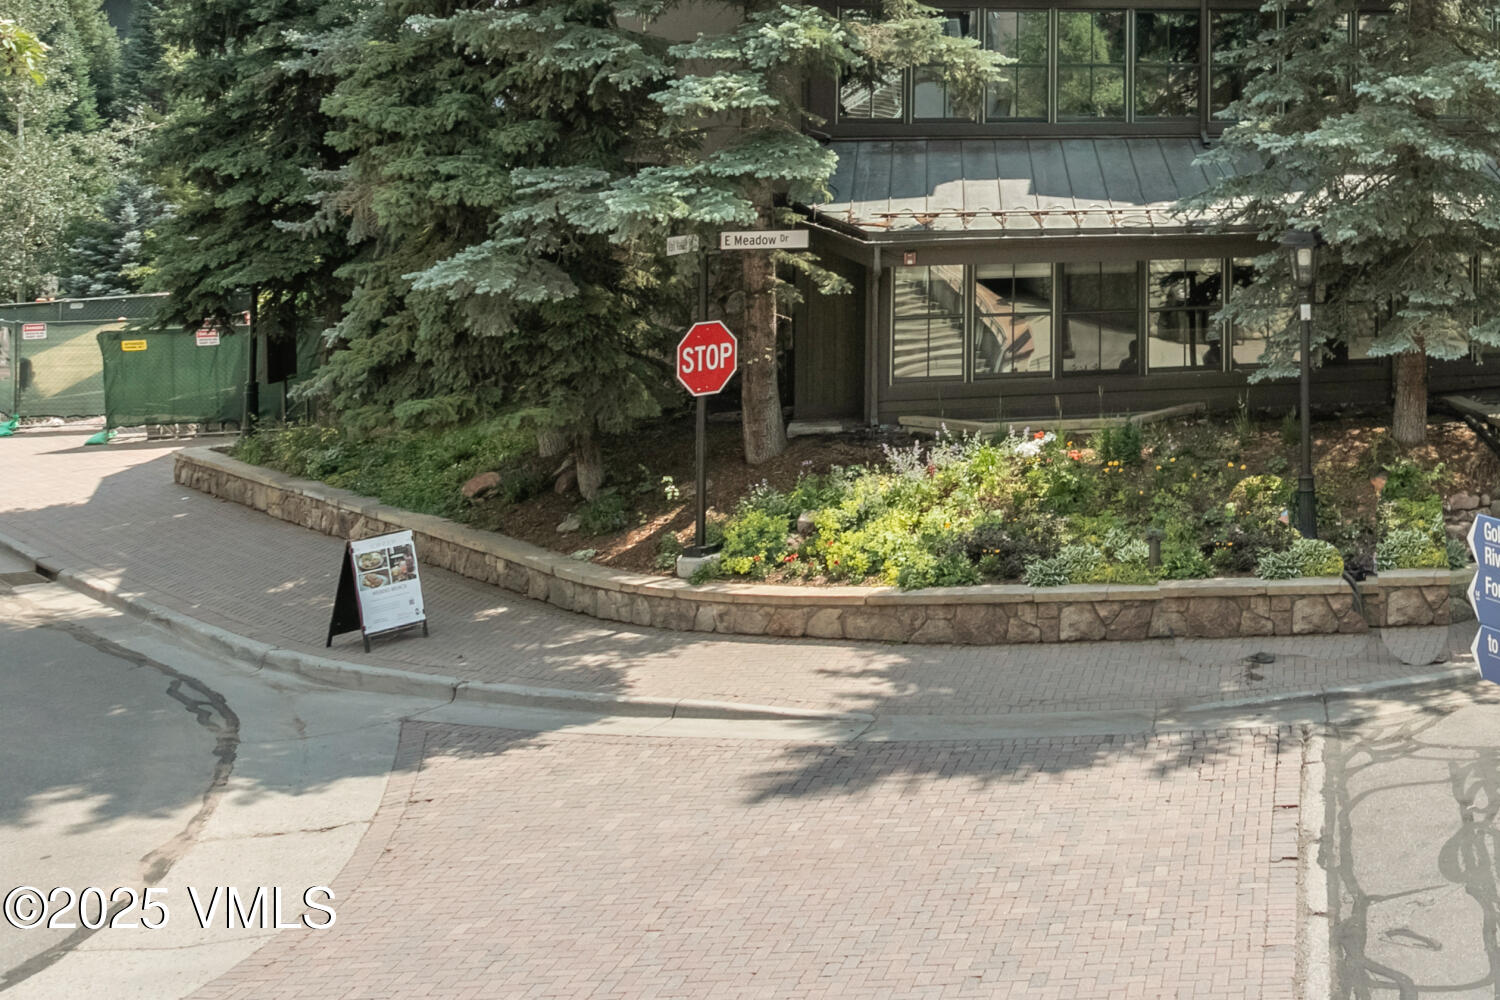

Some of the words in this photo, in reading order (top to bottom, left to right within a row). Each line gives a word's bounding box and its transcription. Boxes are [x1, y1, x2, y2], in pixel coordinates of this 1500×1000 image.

[724, 235, 731, 246] E
[734, 235, 777, 246] Meadow
[779, 234, 789, 243] Dr
[681, 342, 733, 374] STOP
[1487, 633, 1499, 654] to
